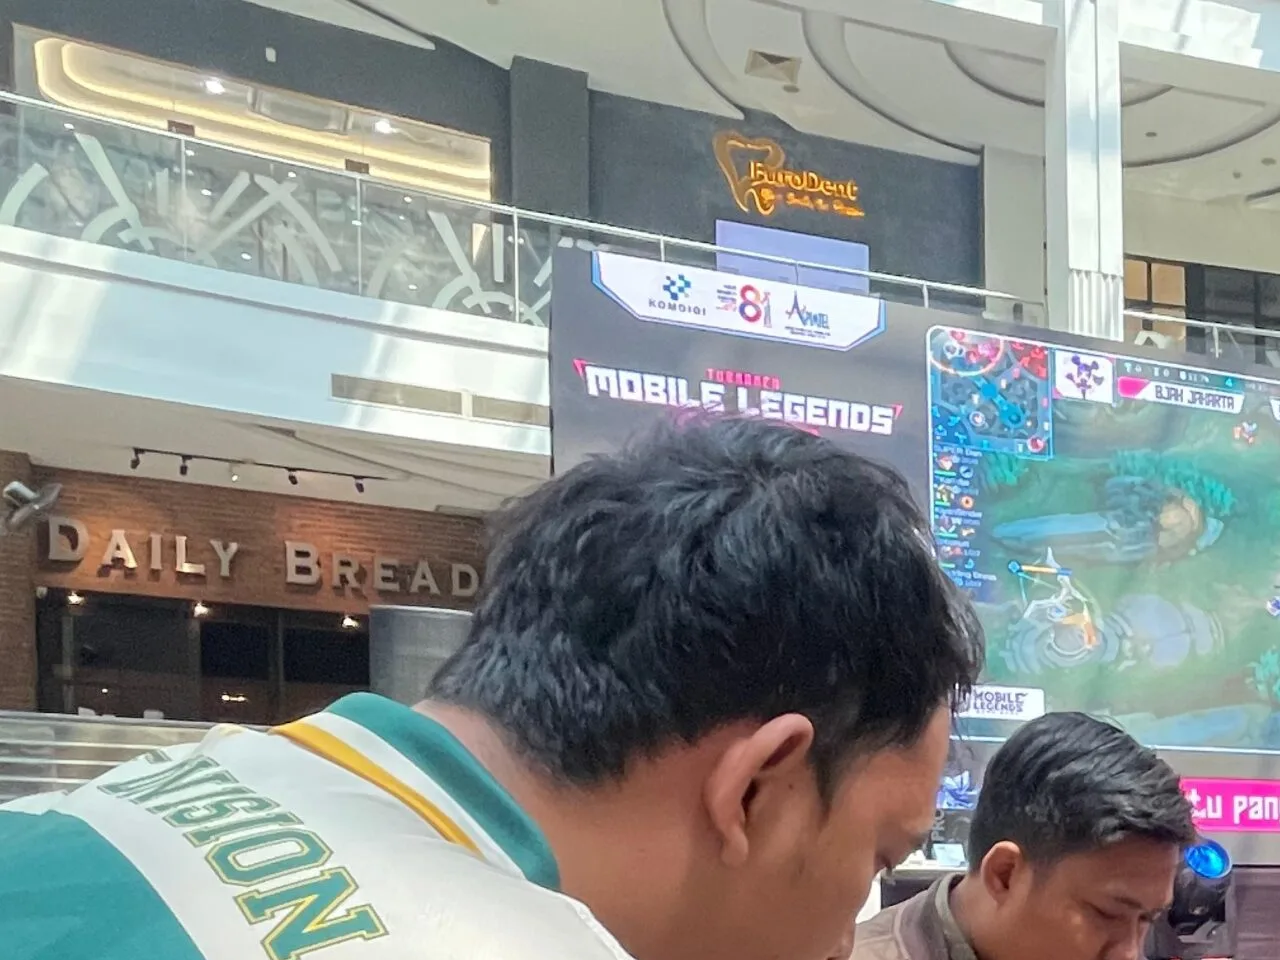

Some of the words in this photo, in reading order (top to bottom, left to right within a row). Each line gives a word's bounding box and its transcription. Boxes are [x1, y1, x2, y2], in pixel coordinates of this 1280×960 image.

[585, 364, 726, 413] MOBILE
[736, 386, 895, 436] LEGENDS
[47, 513, 240, 578] DAILY
[284, 540, 480, 598] BREAD
[973, 701, 1024, 713] LEGENDS
[974, 689, 1029, 704] MOBILE
